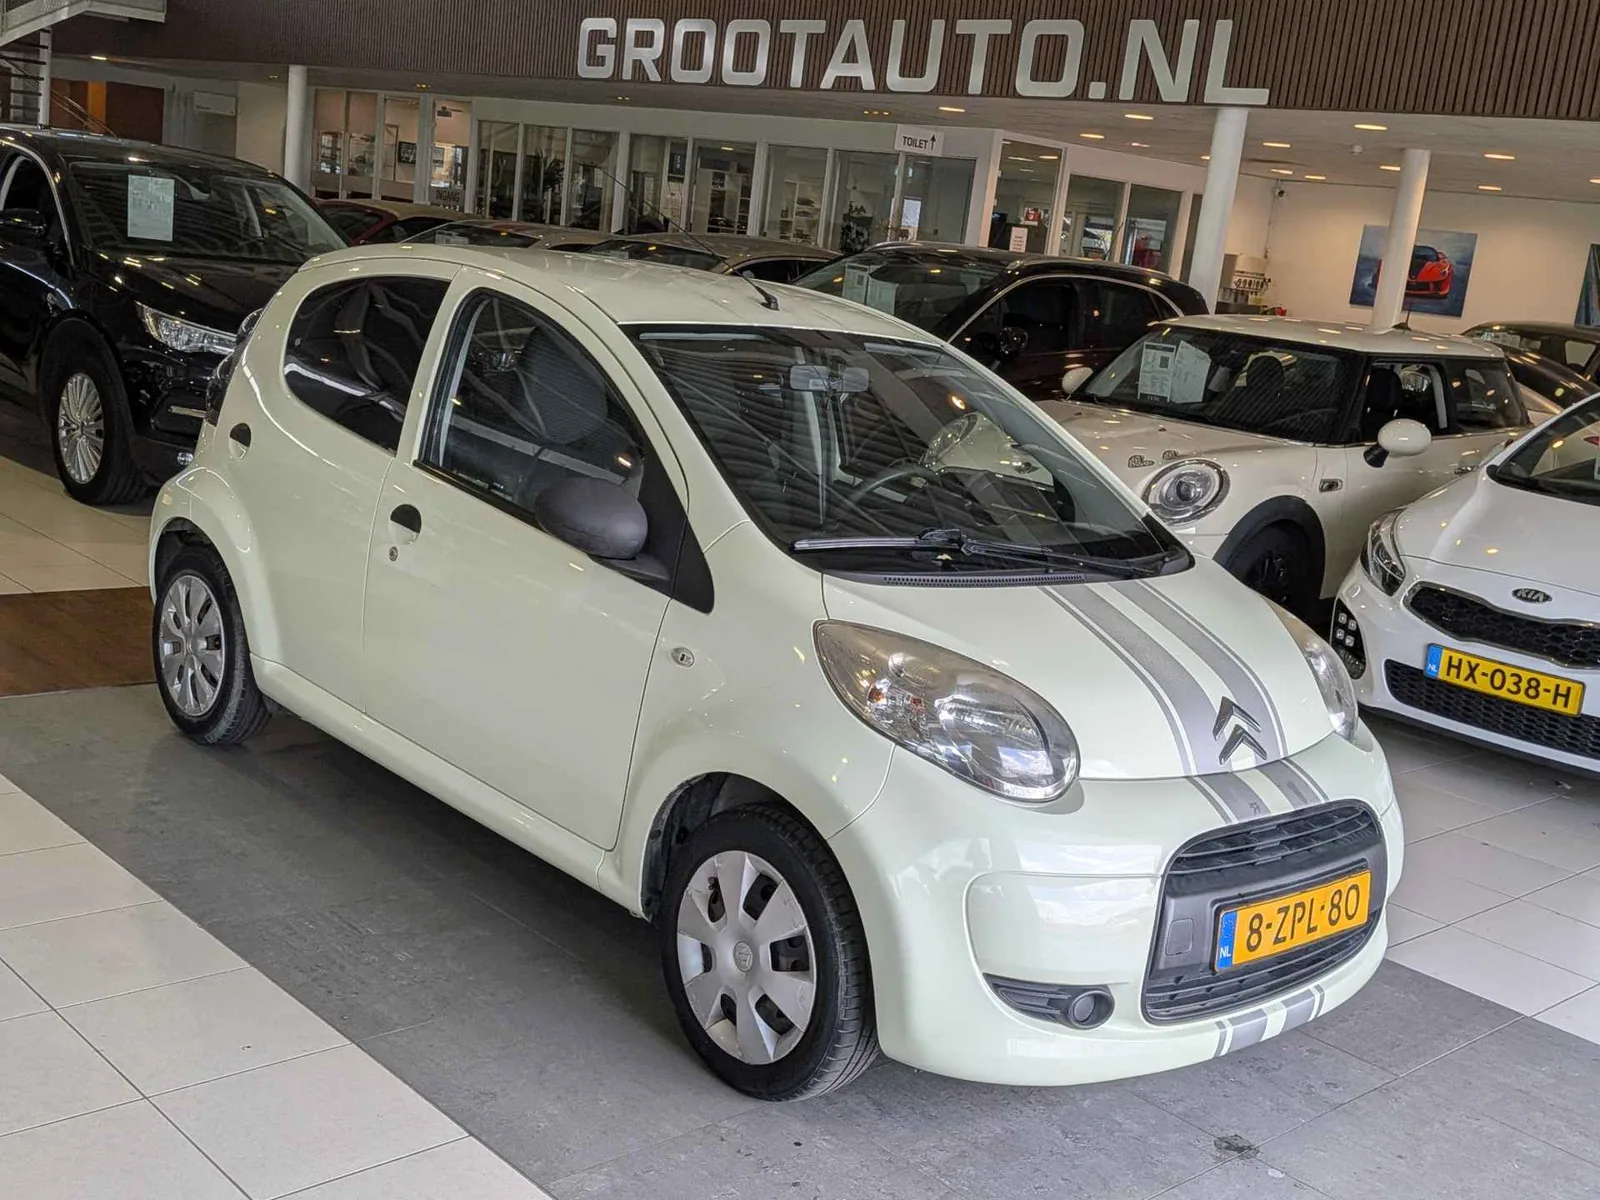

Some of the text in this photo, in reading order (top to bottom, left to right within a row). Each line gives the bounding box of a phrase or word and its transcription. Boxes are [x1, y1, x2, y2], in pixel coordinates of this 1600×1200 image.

[576, 18, 1270, 105] GROOTAUTO.NL
[902, 136, 928, 149] TOILET
[1516, 589, 1546, 602] KIA
[1428, 656, 1571, 708] NL HX-038-H
[1219, 884, 1360, 959] NL 8-ZPL-80
